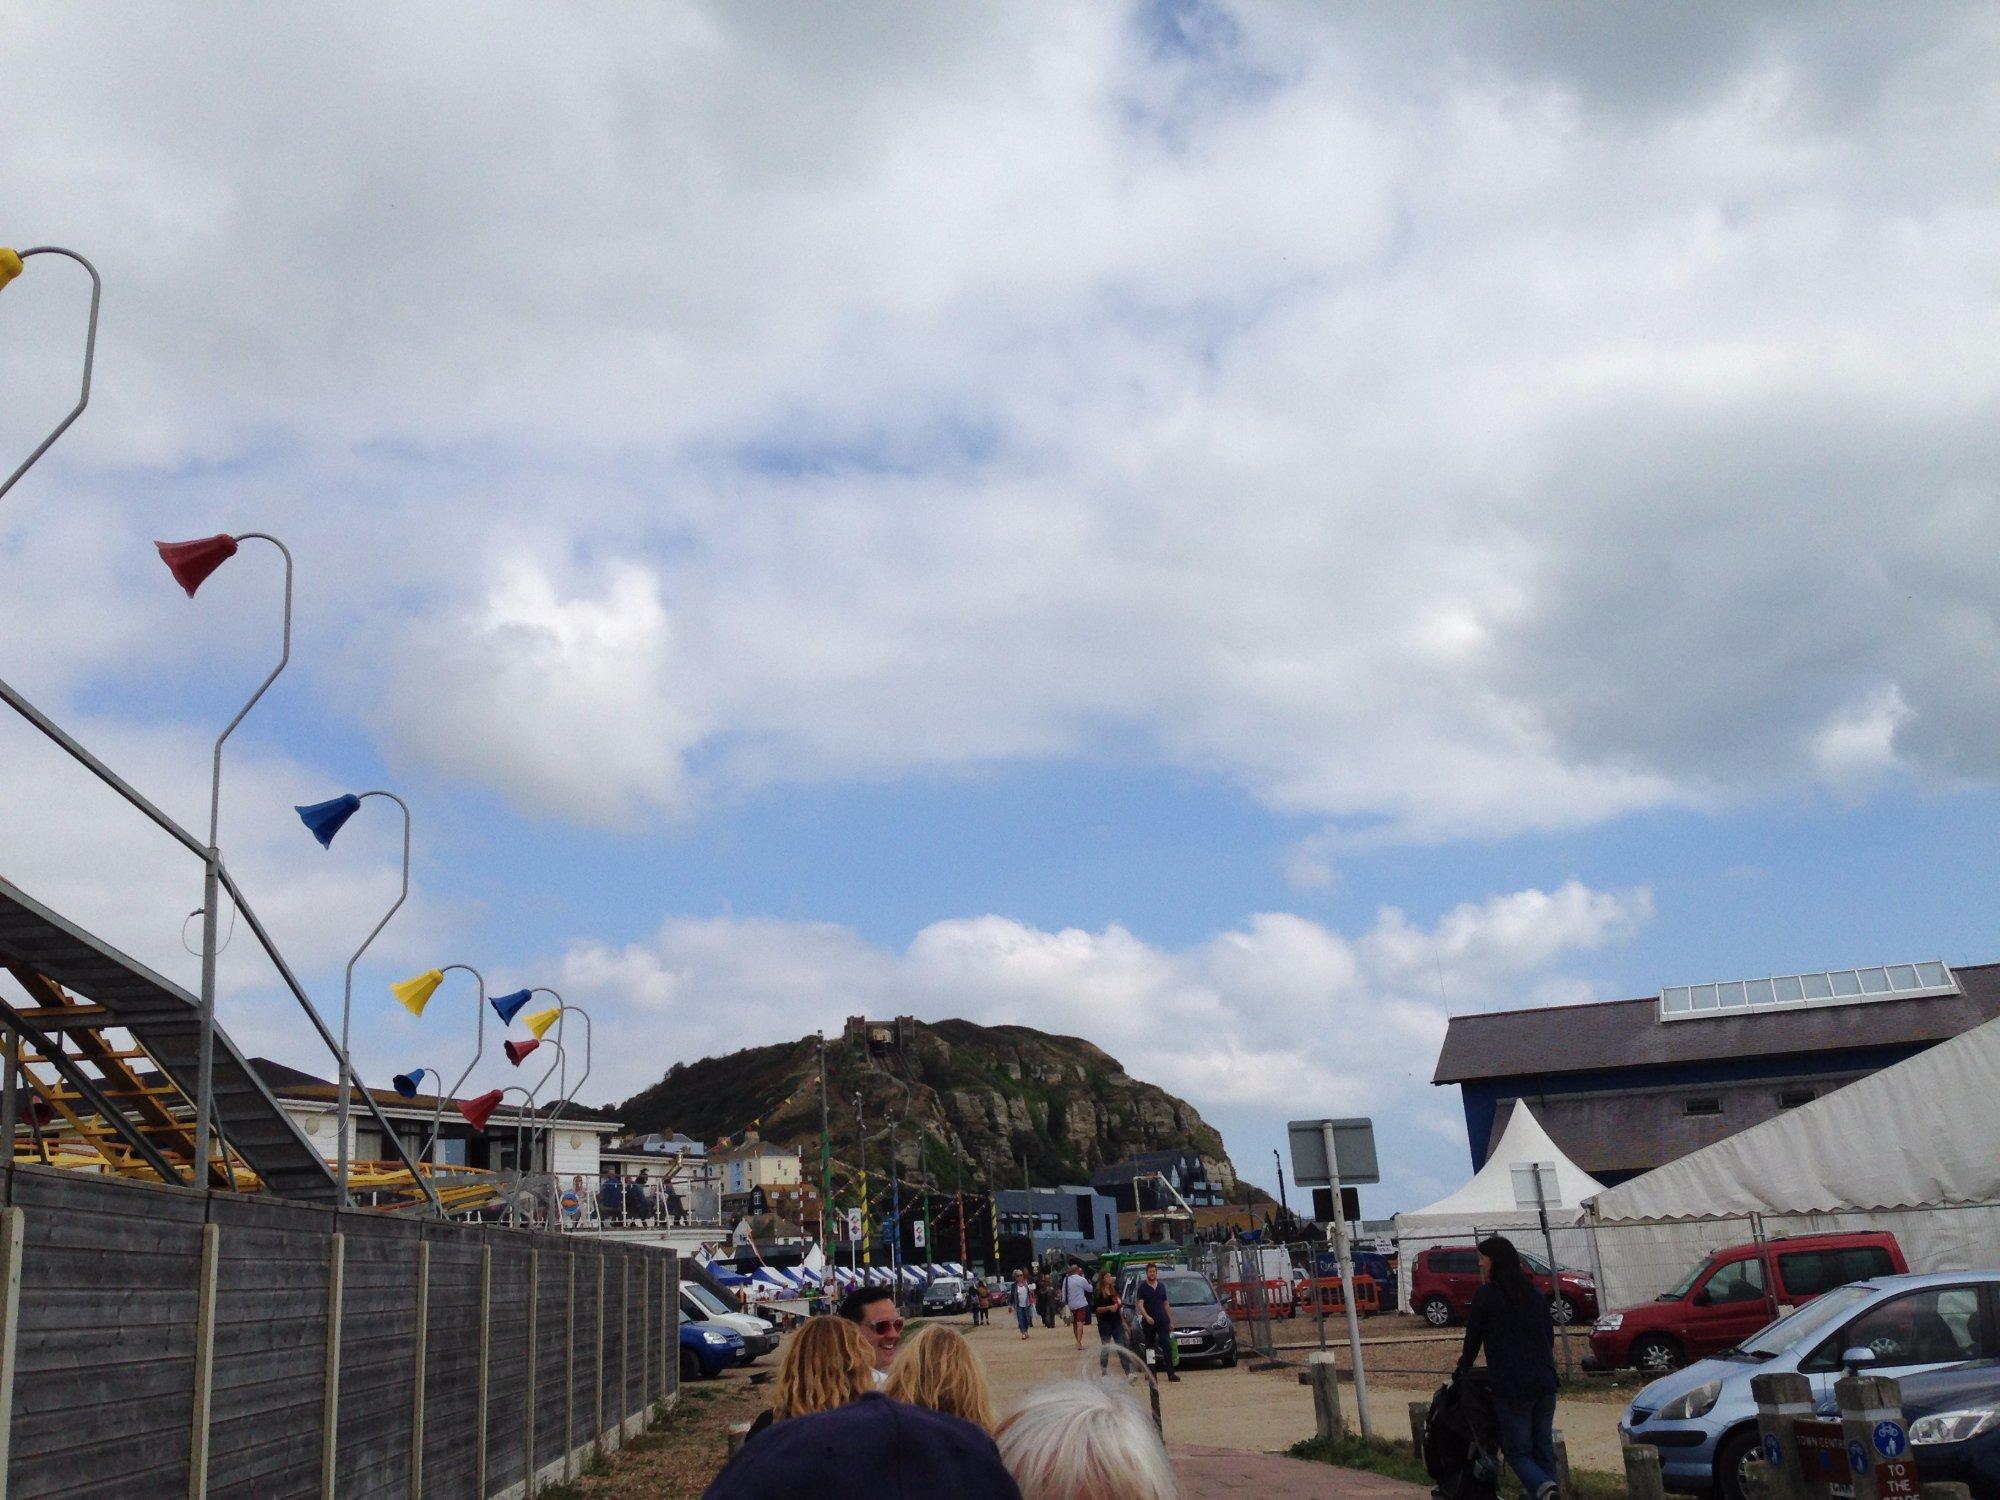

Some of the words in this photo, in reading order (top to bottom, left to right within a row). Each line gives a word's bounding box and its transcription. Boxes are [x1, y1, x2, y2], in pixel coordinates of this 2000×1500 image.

[1796, 1435, 1817, 1448] TOWN
[1887, 1464, 1905, 1477] TO
[1886, 1479, 1911, 1492] THE
